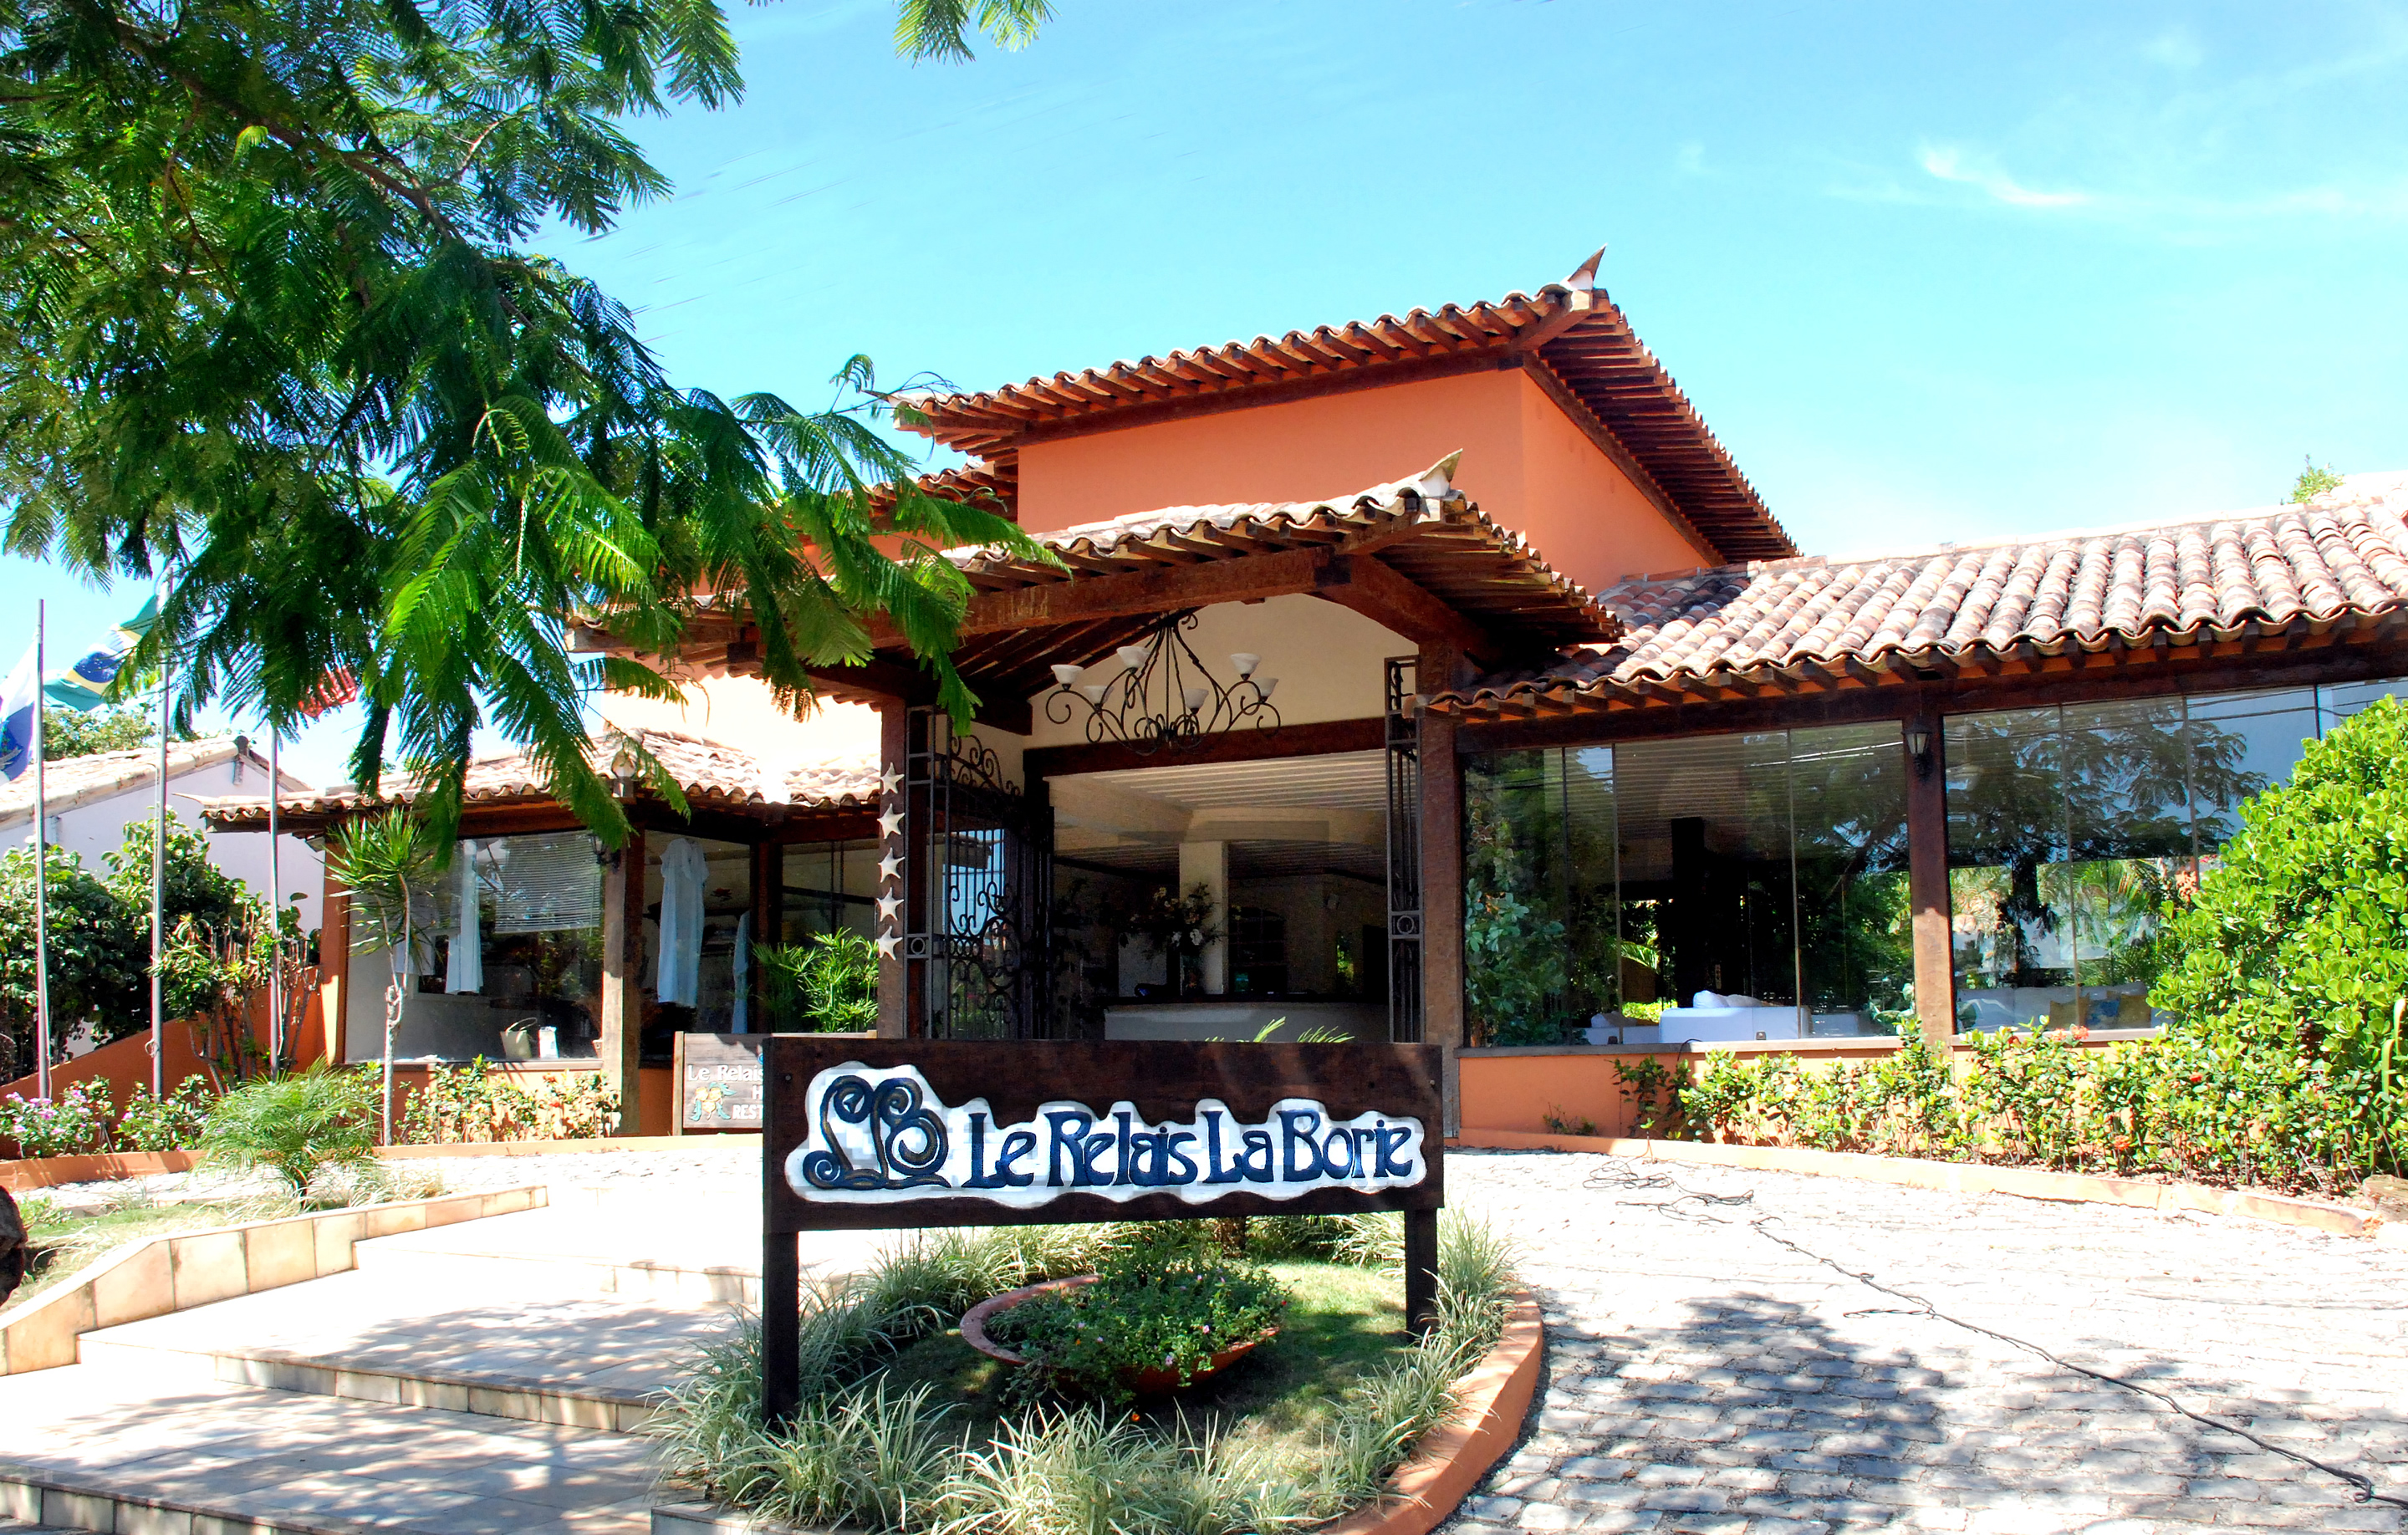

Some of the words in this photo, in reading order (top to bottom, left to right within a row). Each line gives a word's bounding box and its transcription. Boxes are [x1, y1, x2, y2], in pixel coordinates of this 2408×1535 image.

[687, 1064, 710, 1082] Le
[962, 1113, 1037, 1189] Le
[1043, 1110, 1199, 1188] Relais
[1201, 1110, 1274, 1184] La
[1276, 1108, 1413, 1182] Borie
